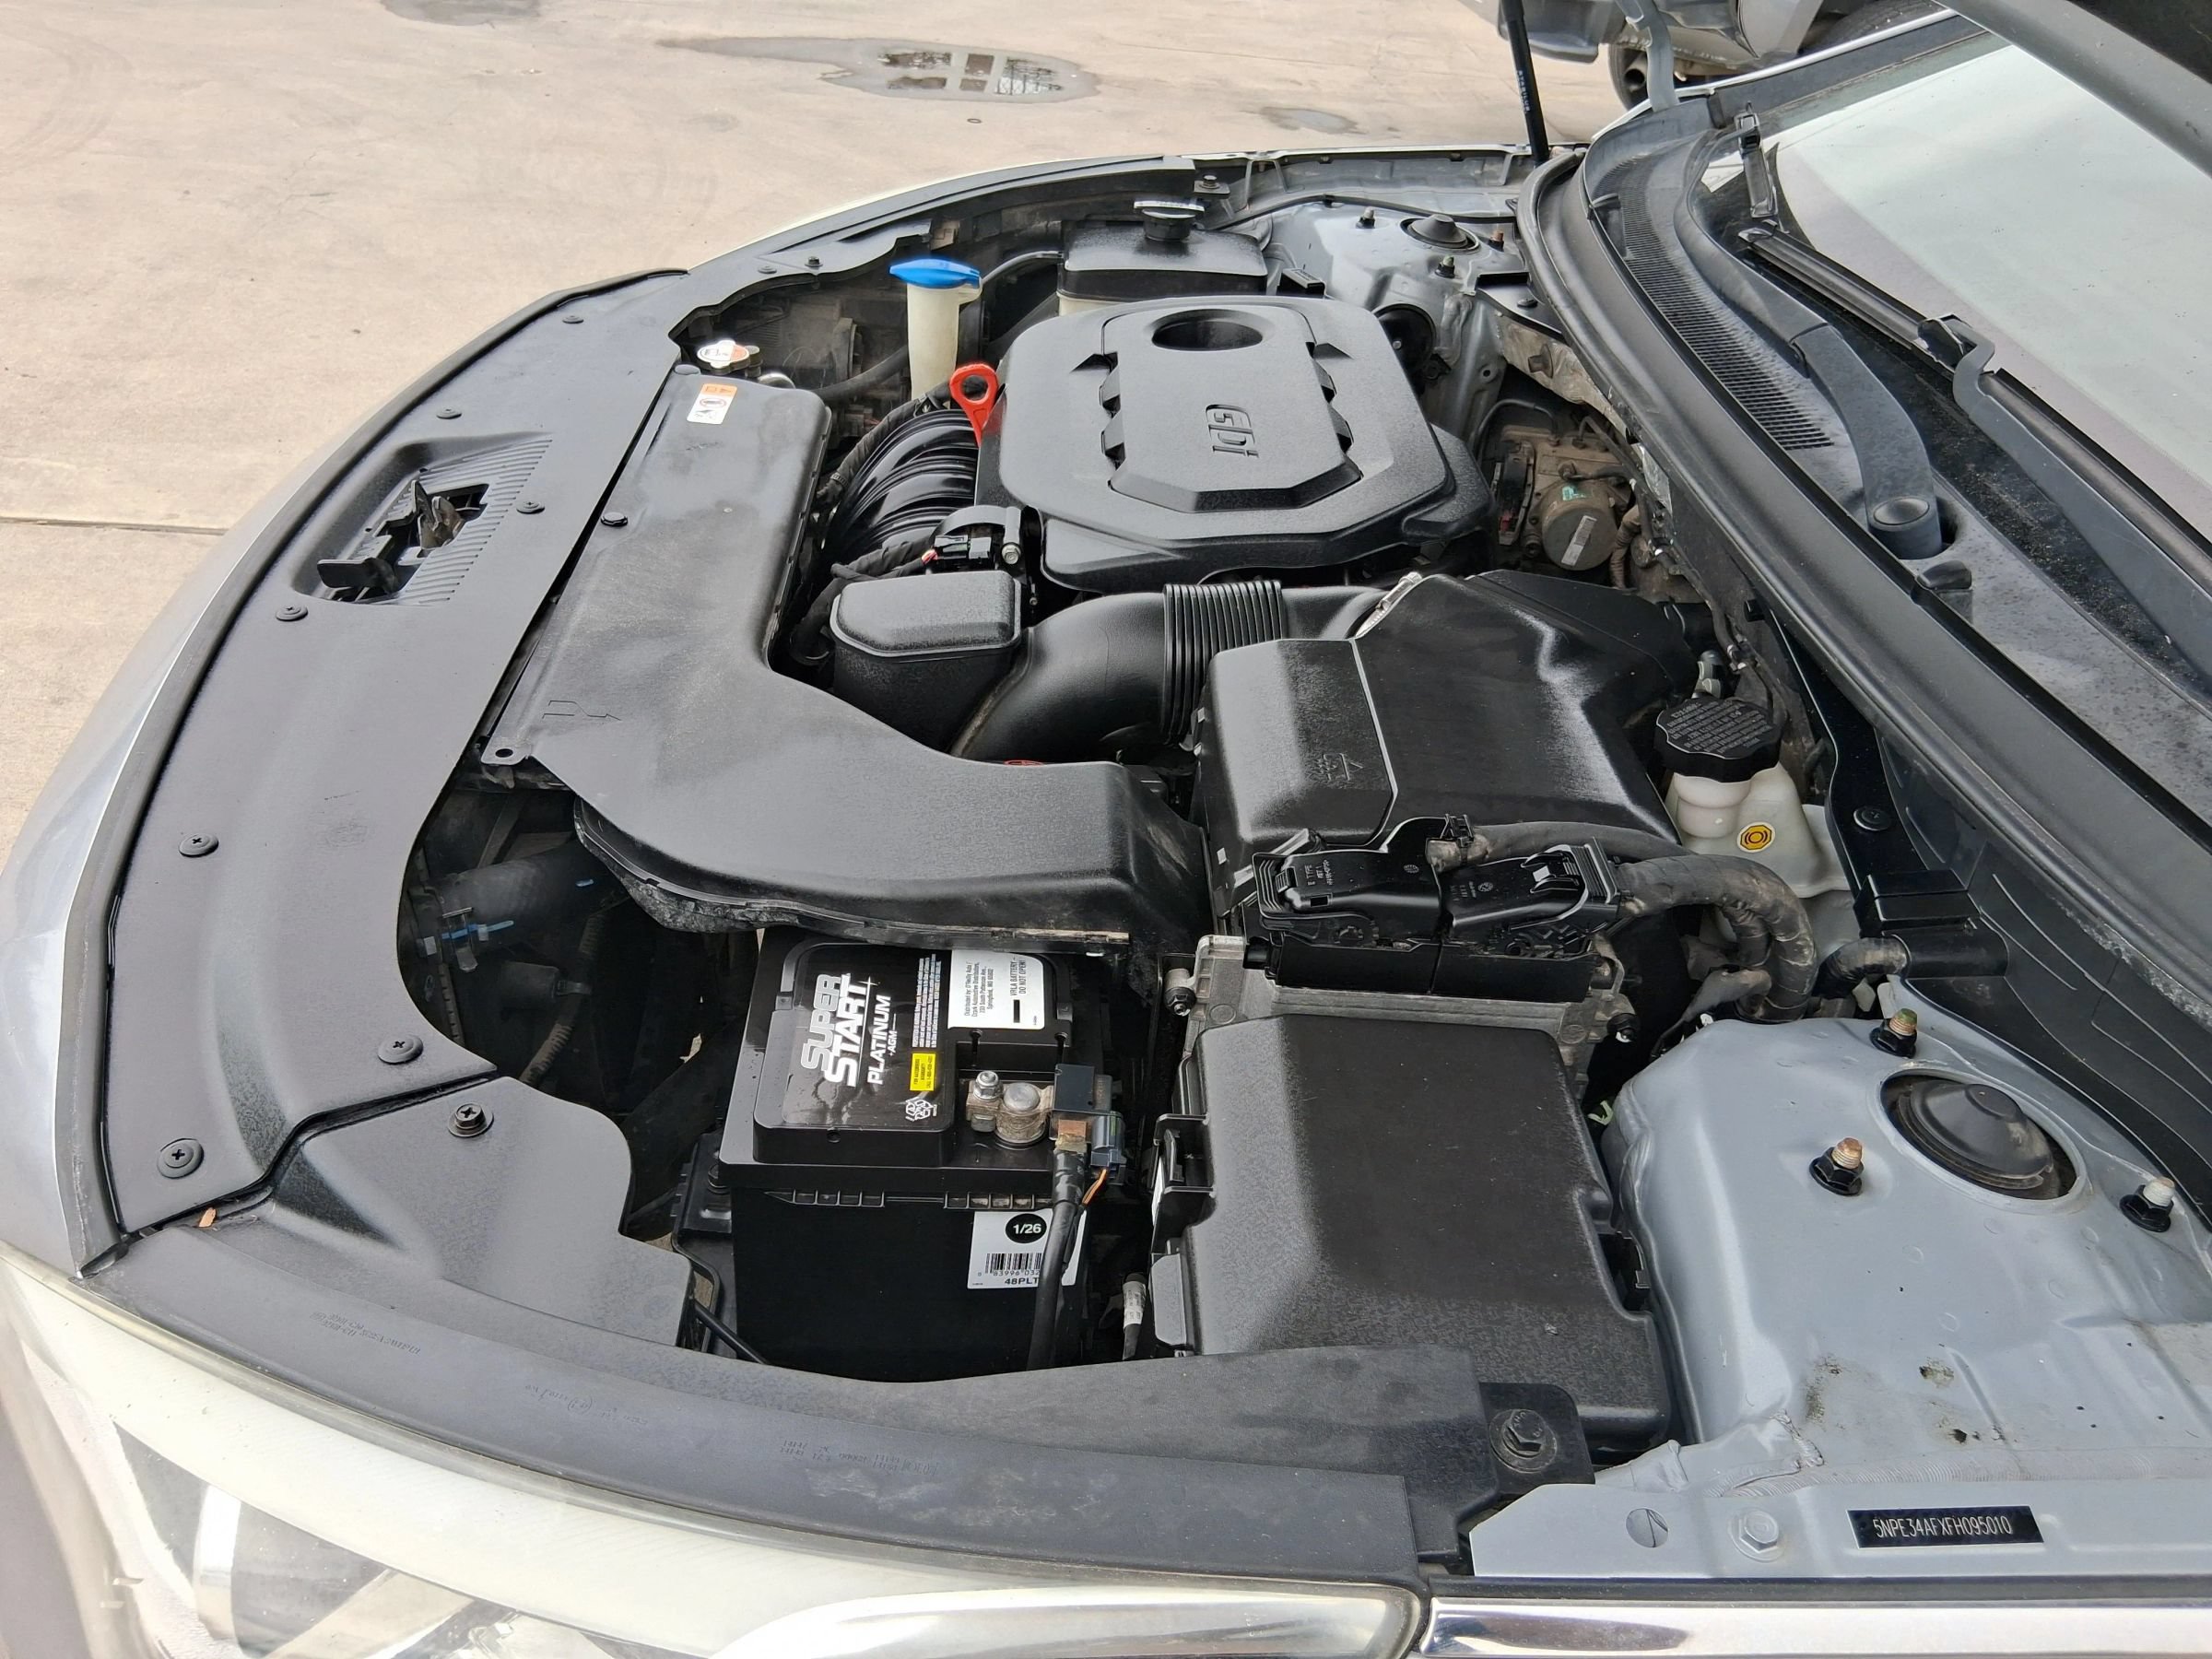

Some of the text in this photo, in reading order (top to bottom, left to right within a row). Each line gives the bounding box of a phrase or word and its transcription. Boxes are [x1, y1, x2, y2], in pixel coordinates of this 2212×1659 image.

[1009, 961, 1018, 982] BATTERY
[1018, 975, 1027, 985] NOT
[1009, 982, 1018, 995] VRLA
[1018, 986, 1027, 994] DO
[800, 973, 841, 1071] SUPER
[824, 973, 867, 1087] START
[866, 994, 891, 1085] PLATINUM
[1012, 1223, 1042, 1235] 1/26
[1872, 1514, 2013, 1539] 5NPE34AFXFH095010
